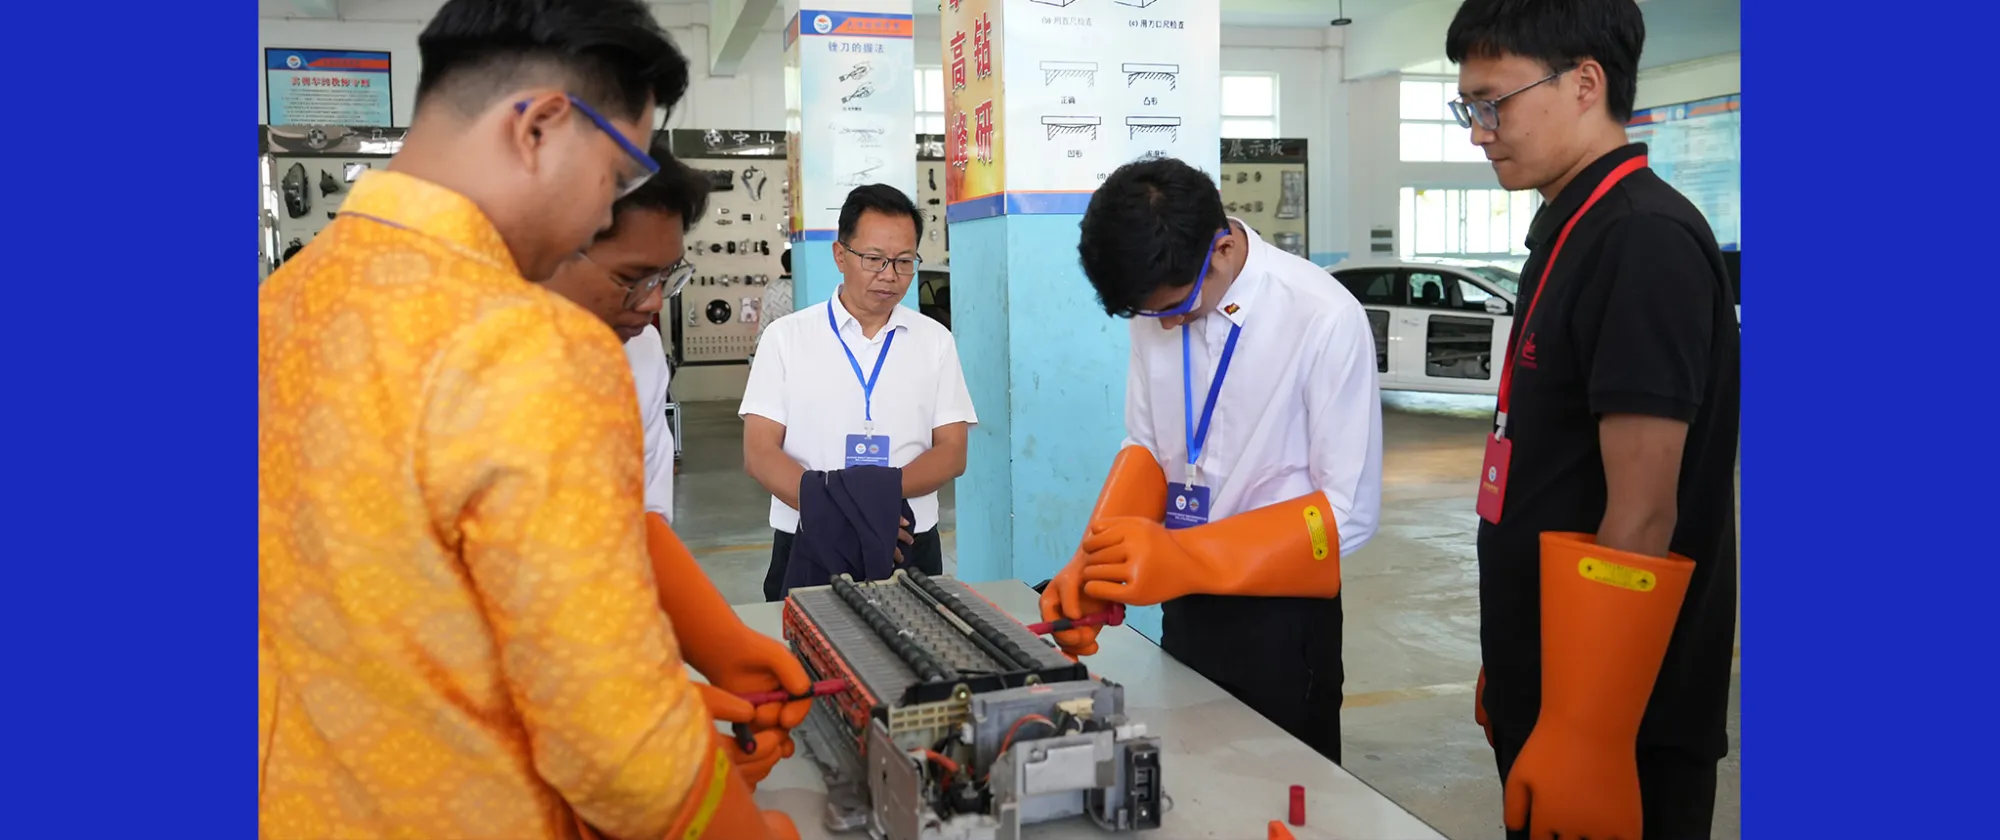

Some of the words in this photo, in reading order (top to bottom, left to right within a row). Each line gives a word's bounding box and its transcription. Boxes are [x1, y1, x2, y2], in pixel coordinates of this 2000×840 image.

[1128, 19, 1139, 28] (c)
[974, 11, 993, 164] 钻研
[1221, 139, 1284, 157] 展示板
